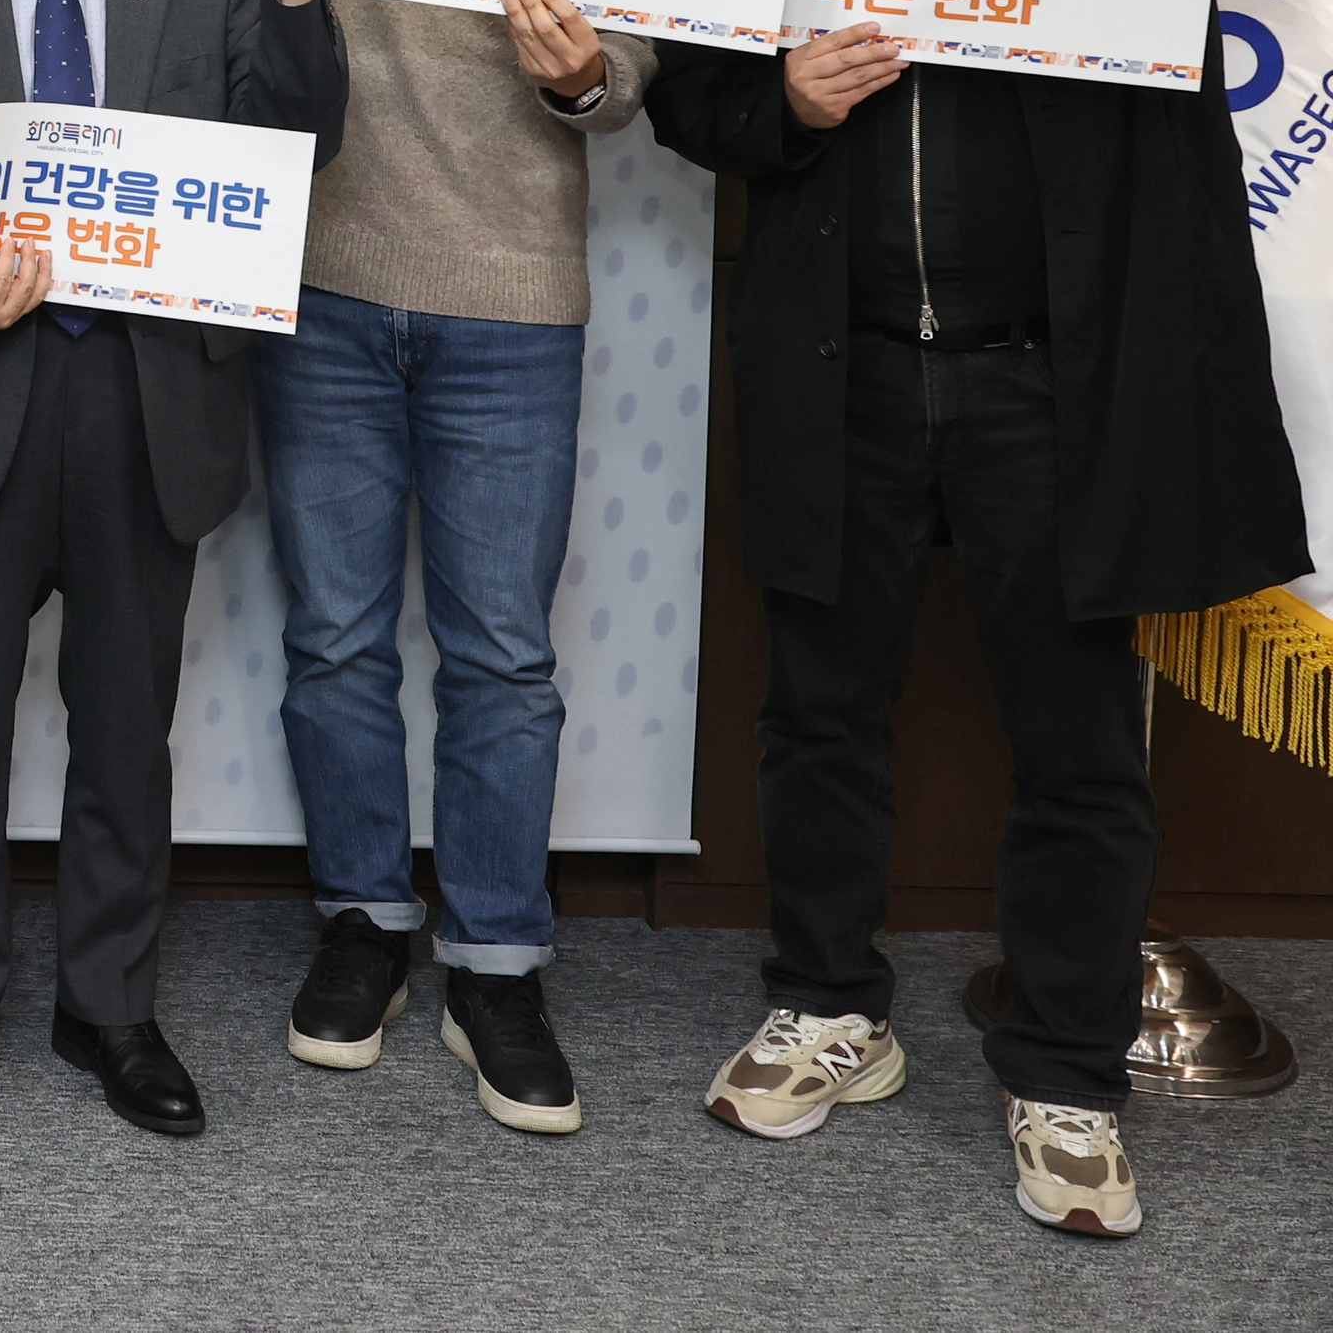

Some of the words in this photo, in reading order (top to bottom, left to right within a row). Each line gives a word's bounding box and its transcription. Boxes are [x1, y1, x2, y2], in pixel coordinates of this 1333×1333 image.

[1249, 69, 1333, 230] WASE
[23, 161, 158, 216] 건강을
[173, 179, 269, 230] 위한
[68, 218, 160, 268] 변화
